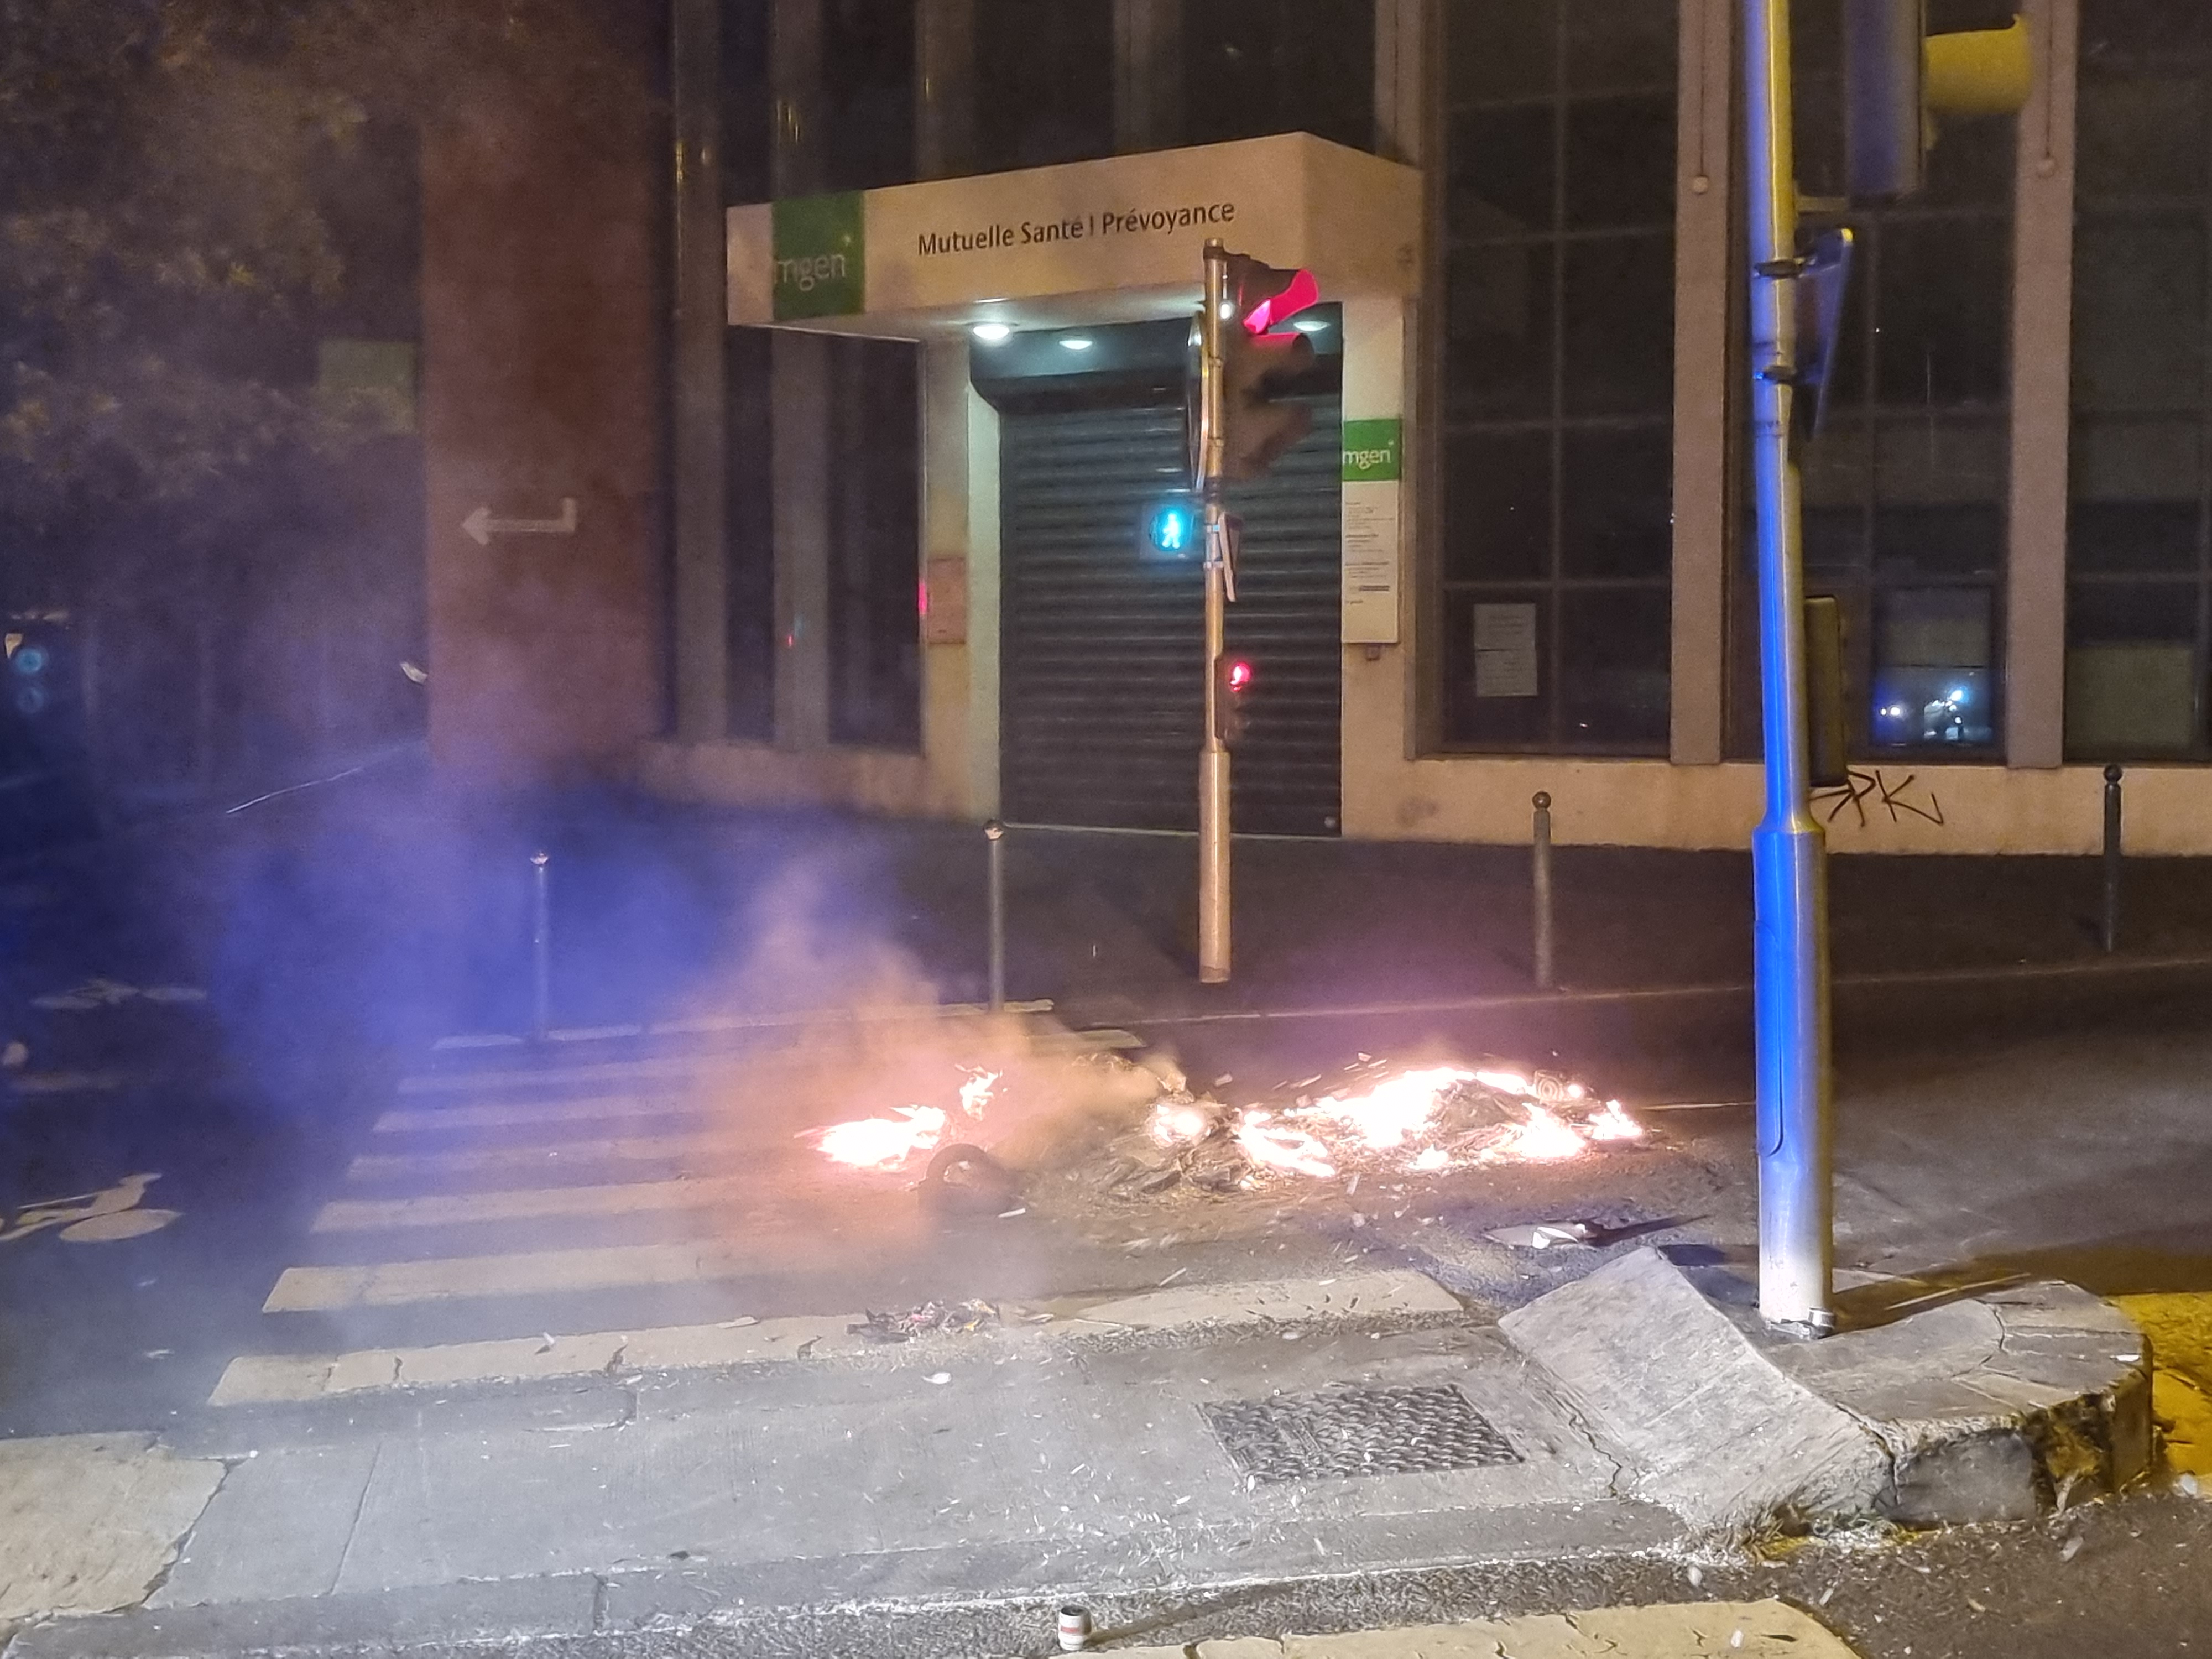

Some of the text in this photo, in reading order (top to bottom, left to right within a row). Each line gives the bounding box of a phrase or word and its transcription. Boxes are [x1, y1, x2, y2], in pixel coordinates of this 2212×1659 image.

[918, 224, 1014, 255] Mutuelle
[1021, 216, 1083, 244] Santé
[1103, 202, 1235, 235] Prévoyance
[775, 253, 846, 292] mgen
[1342, 448, 1392, 470] mgen
